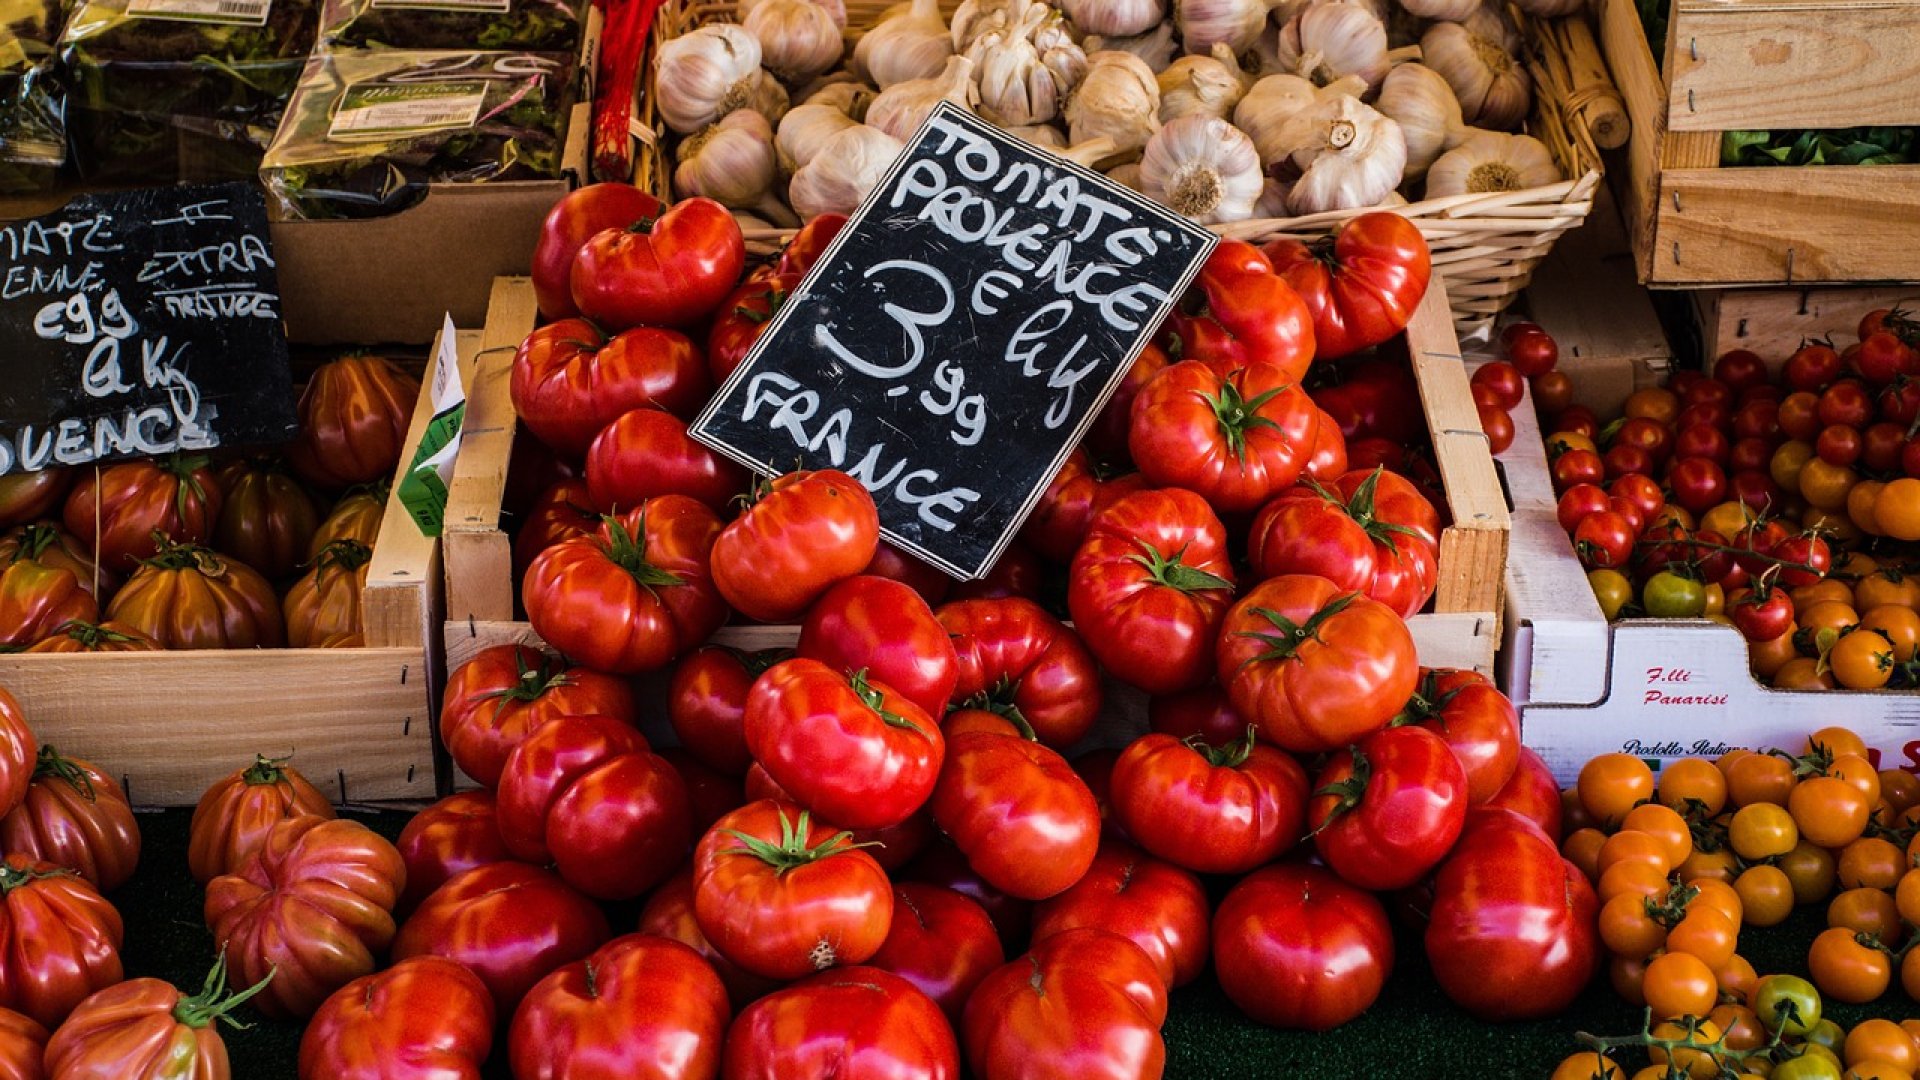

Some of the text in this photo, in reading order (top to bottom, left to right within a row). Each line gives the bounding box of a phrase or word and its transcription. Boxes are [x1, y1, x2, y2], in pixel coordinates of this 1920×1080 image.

[928, 116, 1173, 266] TOMATE
[136, 234, 276, 283] EXTRA
[890, 158, 1169, 331] PROVENCE
[741, 371, 982, 532] FRANCE
[1644, 690, 1729, 707] Panarisi
[1646, 665, 1691, 685] F.lli
[1619, 738, 1684, 756] Prodotto
